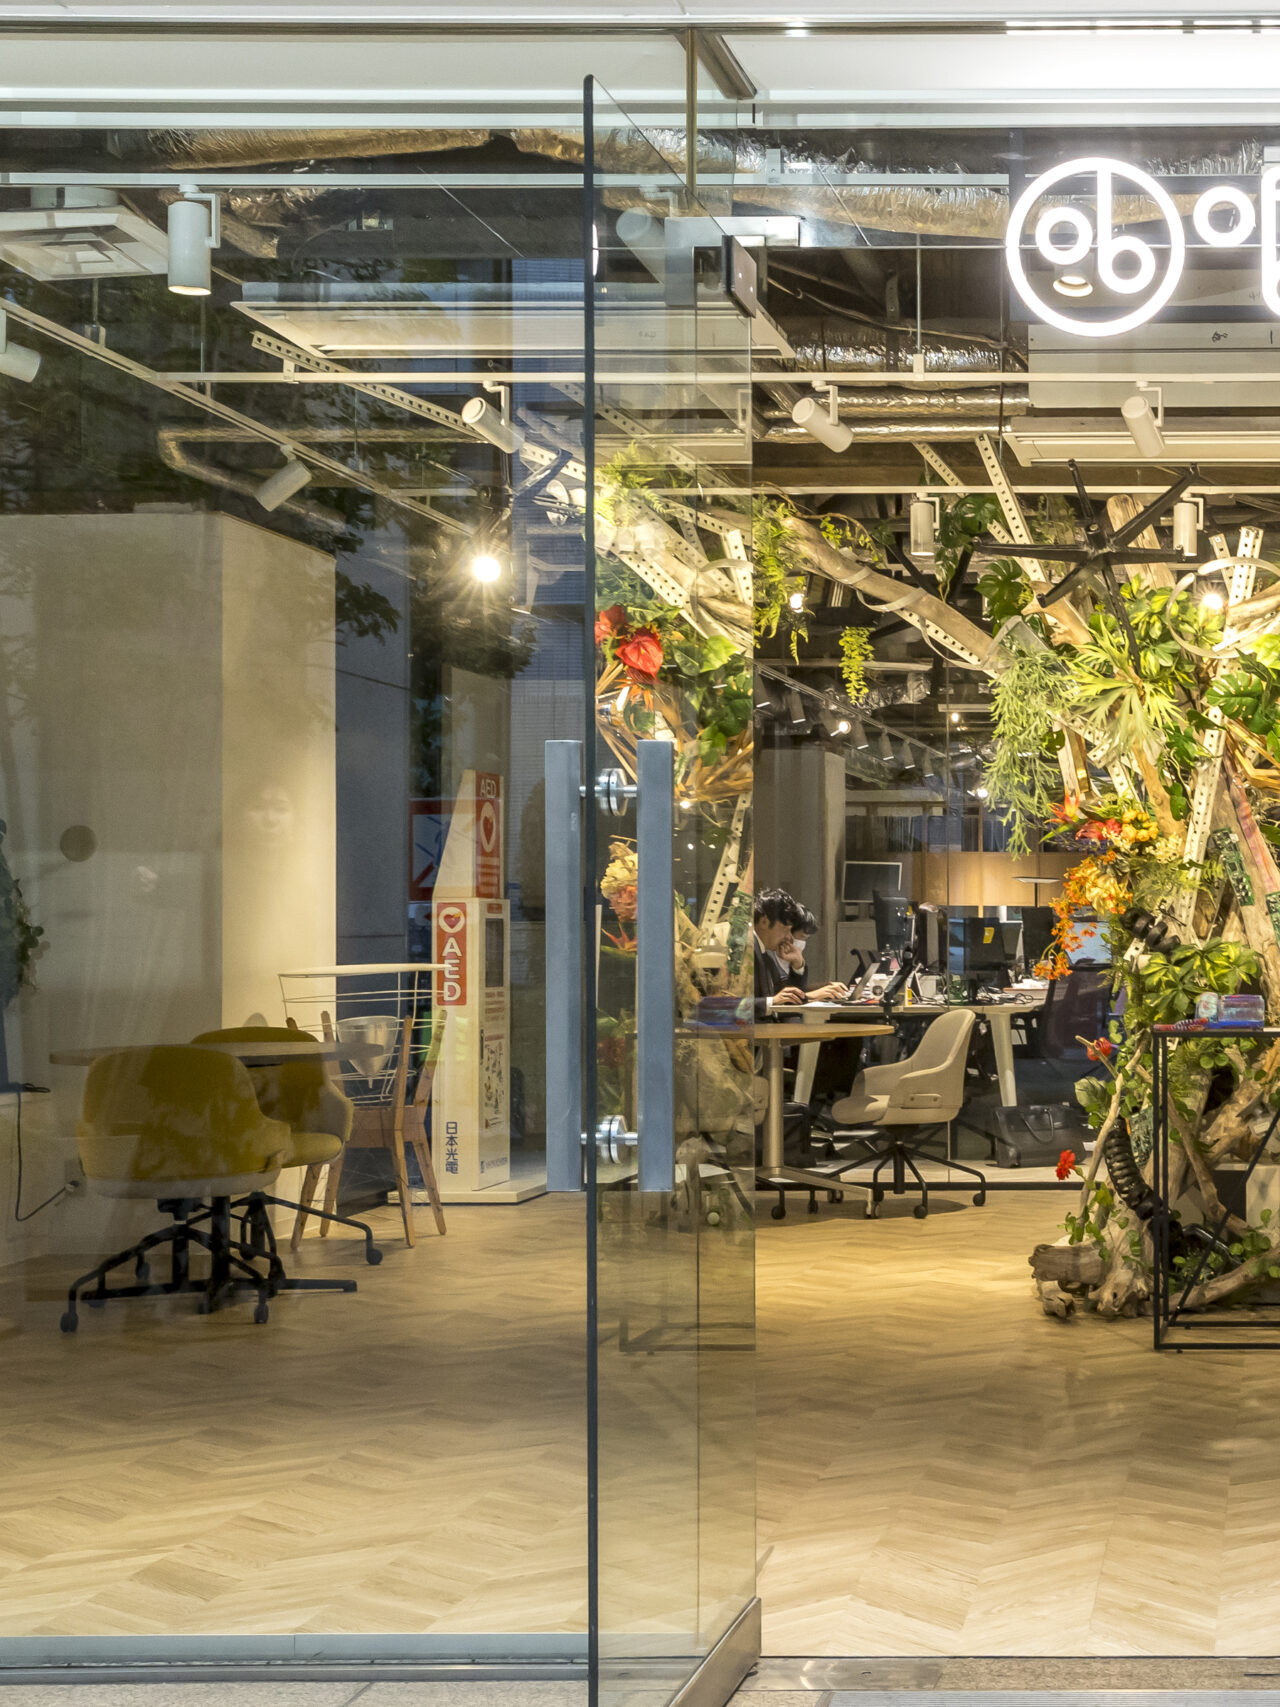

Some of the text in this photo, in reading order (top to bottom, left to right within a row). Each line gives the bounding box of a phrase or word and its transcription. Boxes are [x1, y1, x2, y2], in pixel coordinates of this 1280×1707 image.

[480, 777, 497, 799] AED
[441, 936, 463, 1001] AED
[445, 1121, 459, 1175] 日本光電
